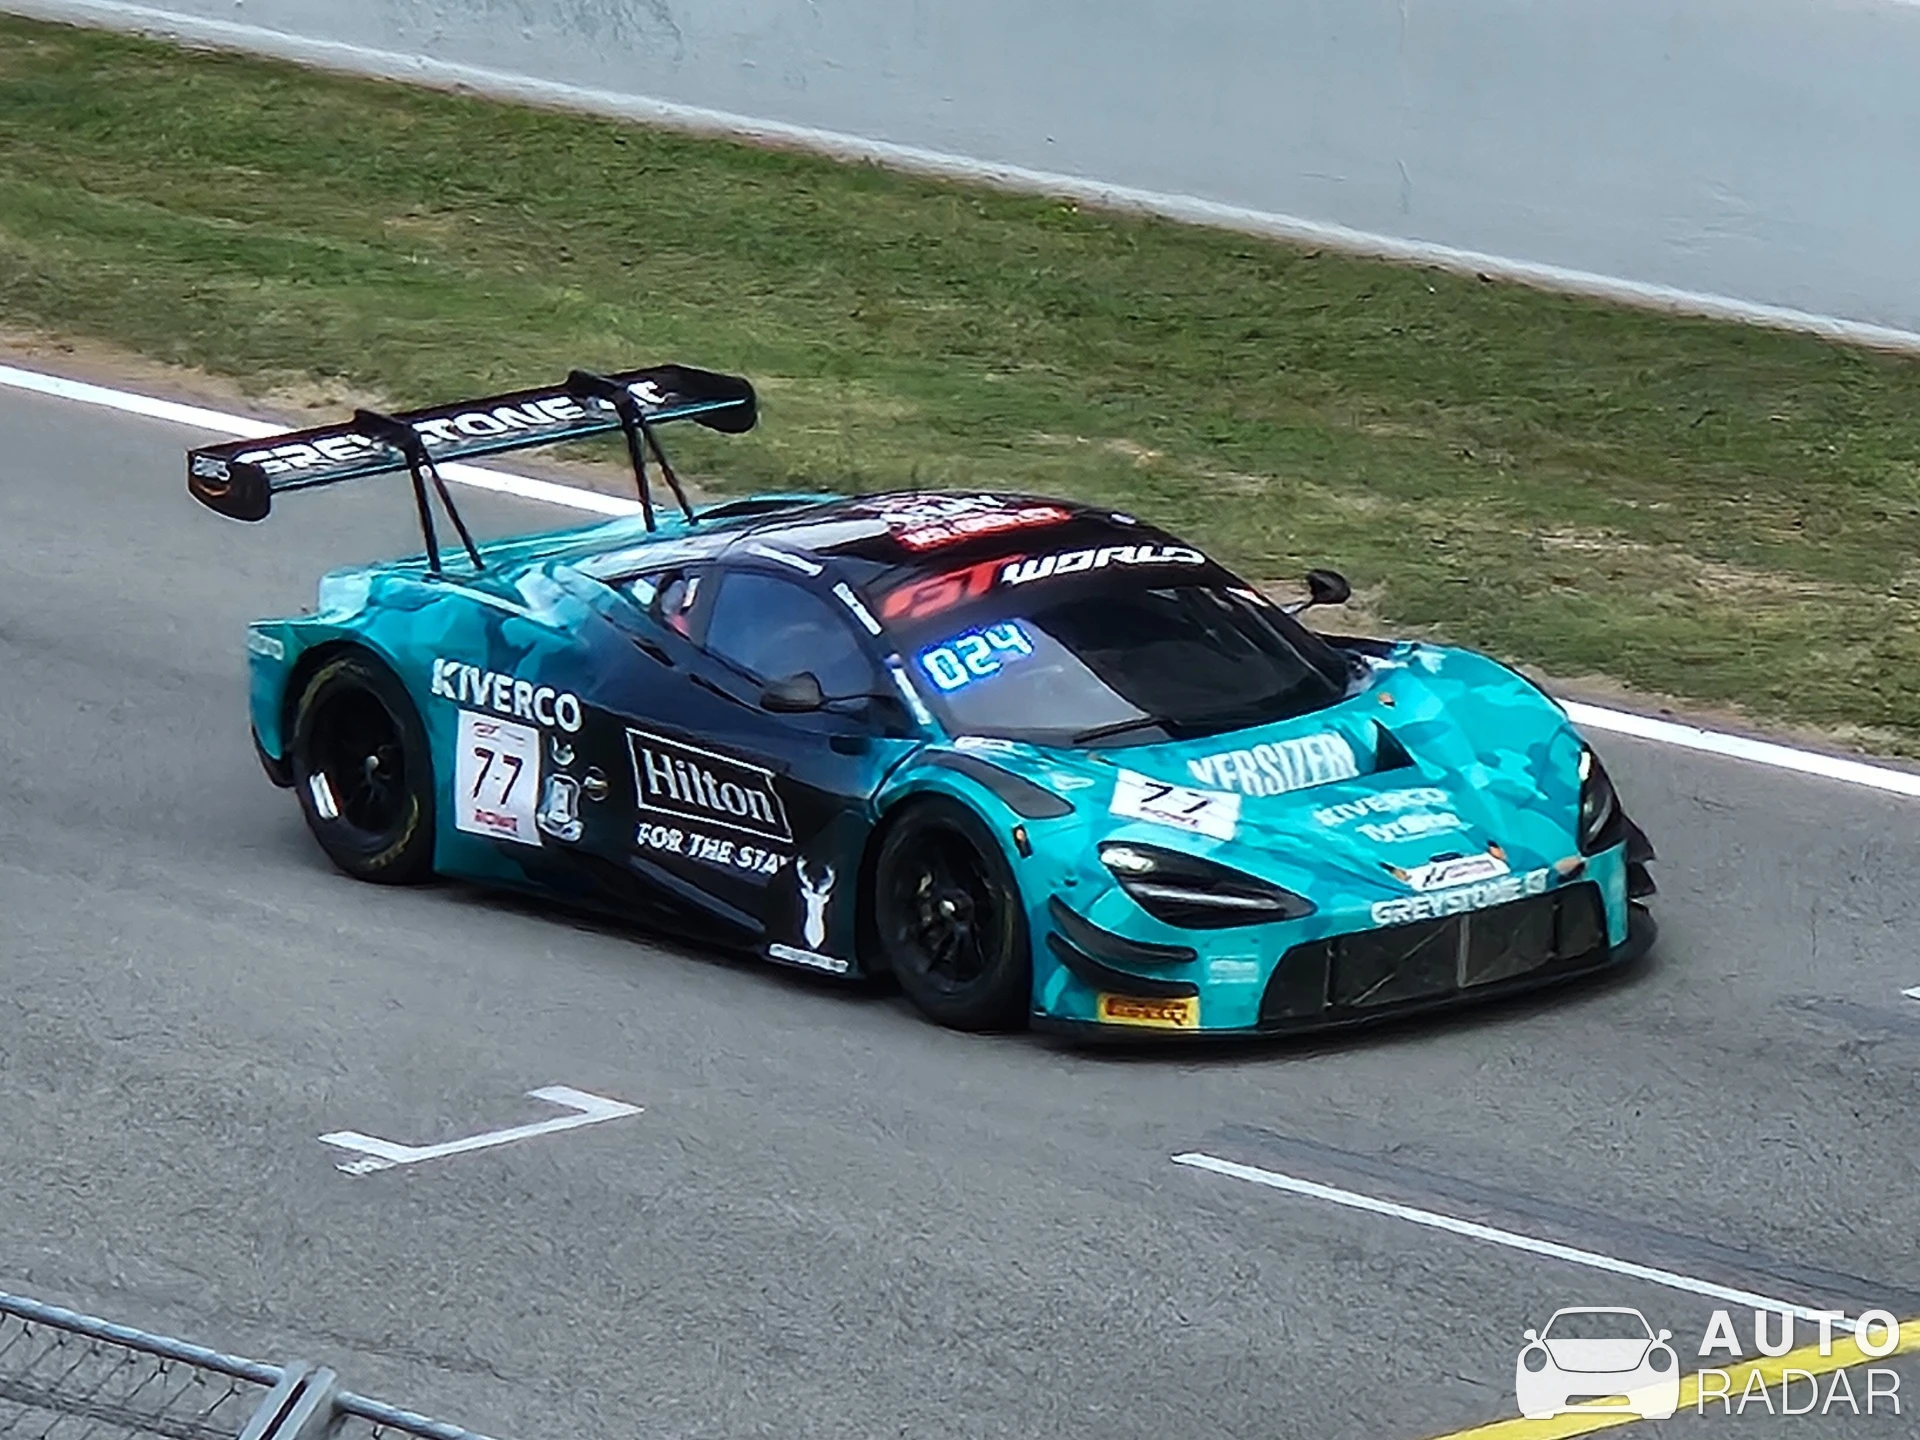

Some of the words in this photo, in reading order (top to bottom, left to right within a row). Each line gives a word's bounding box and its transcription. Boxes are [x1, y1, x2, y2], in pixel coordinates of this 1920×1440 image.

[1002, 545, 1205, 585] WORLD
[921, 622, 1032, 693] 024
[431, 658, 583, 733] KIVERCO
[473, 747, 523, 806] 77
[641, 749, 778, 824] Hilton
[1141, 782, 1214, 814] 77
[1313, 787, 1449, 827] KIVERCO
[637, 822, 684, 853] FOR
[689, 833, 735, 864] THE
